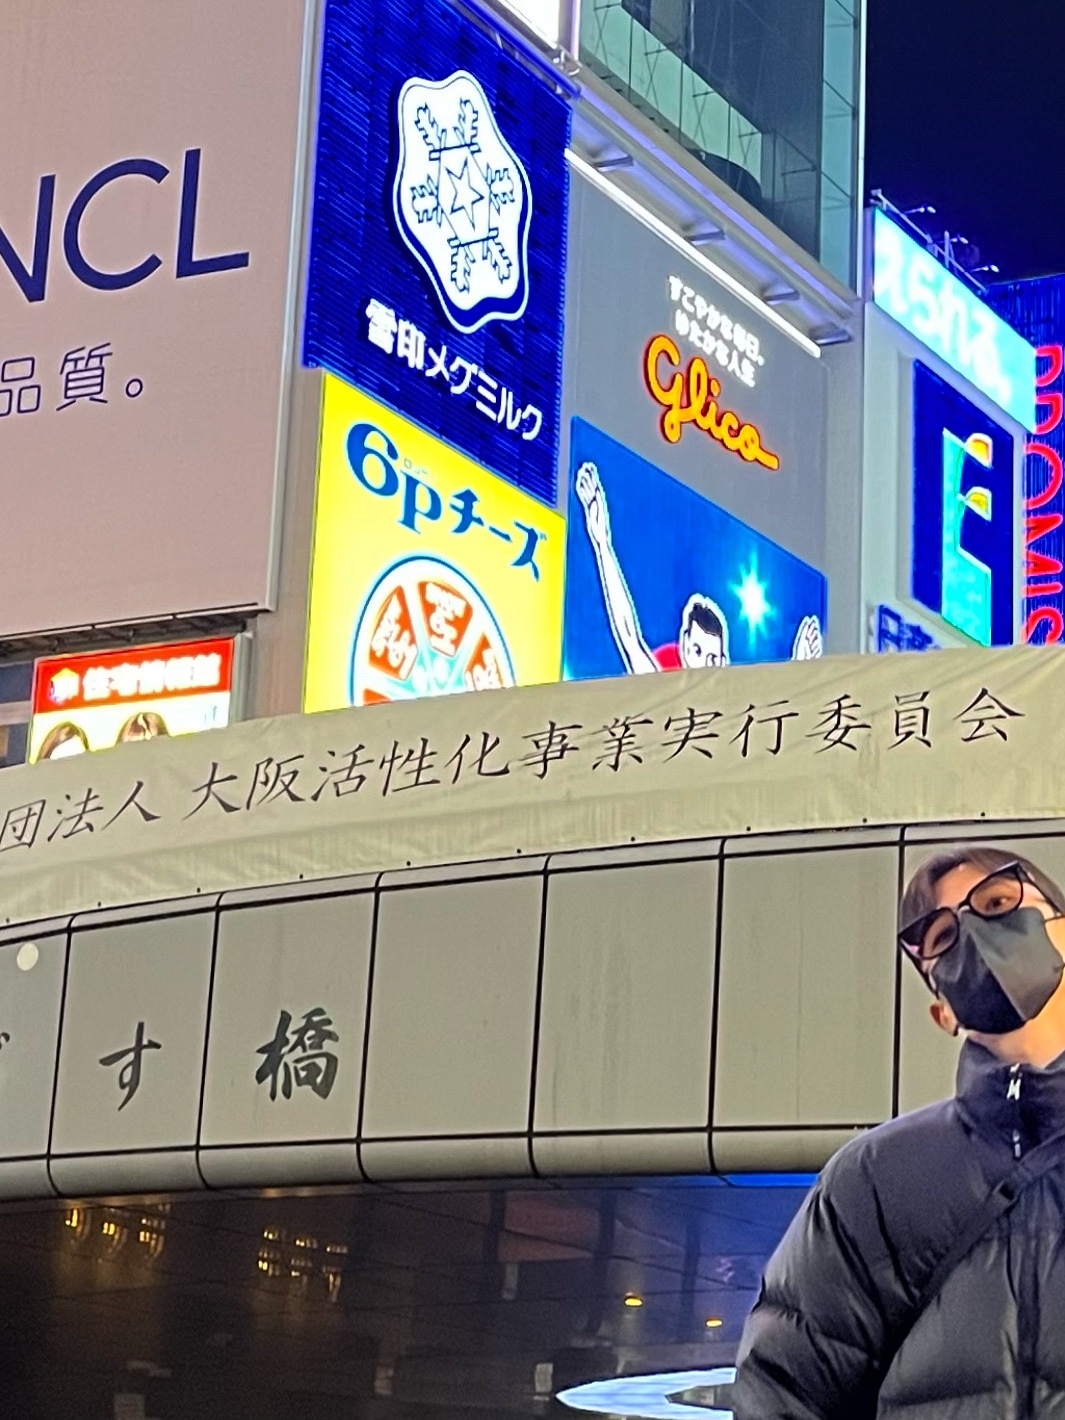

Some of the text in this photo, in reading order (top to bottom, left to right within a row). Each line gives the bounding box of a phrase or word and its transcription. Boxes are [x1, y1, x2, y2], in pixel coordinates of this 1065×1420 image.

[0, 342, 144, 417] 品質。
[365, 298, 543, 441] 雪印メグミルク
[643, 333, 780, 471] Glico
[181, 686, 1025, 821] 大阪活性化事業実行委員会
